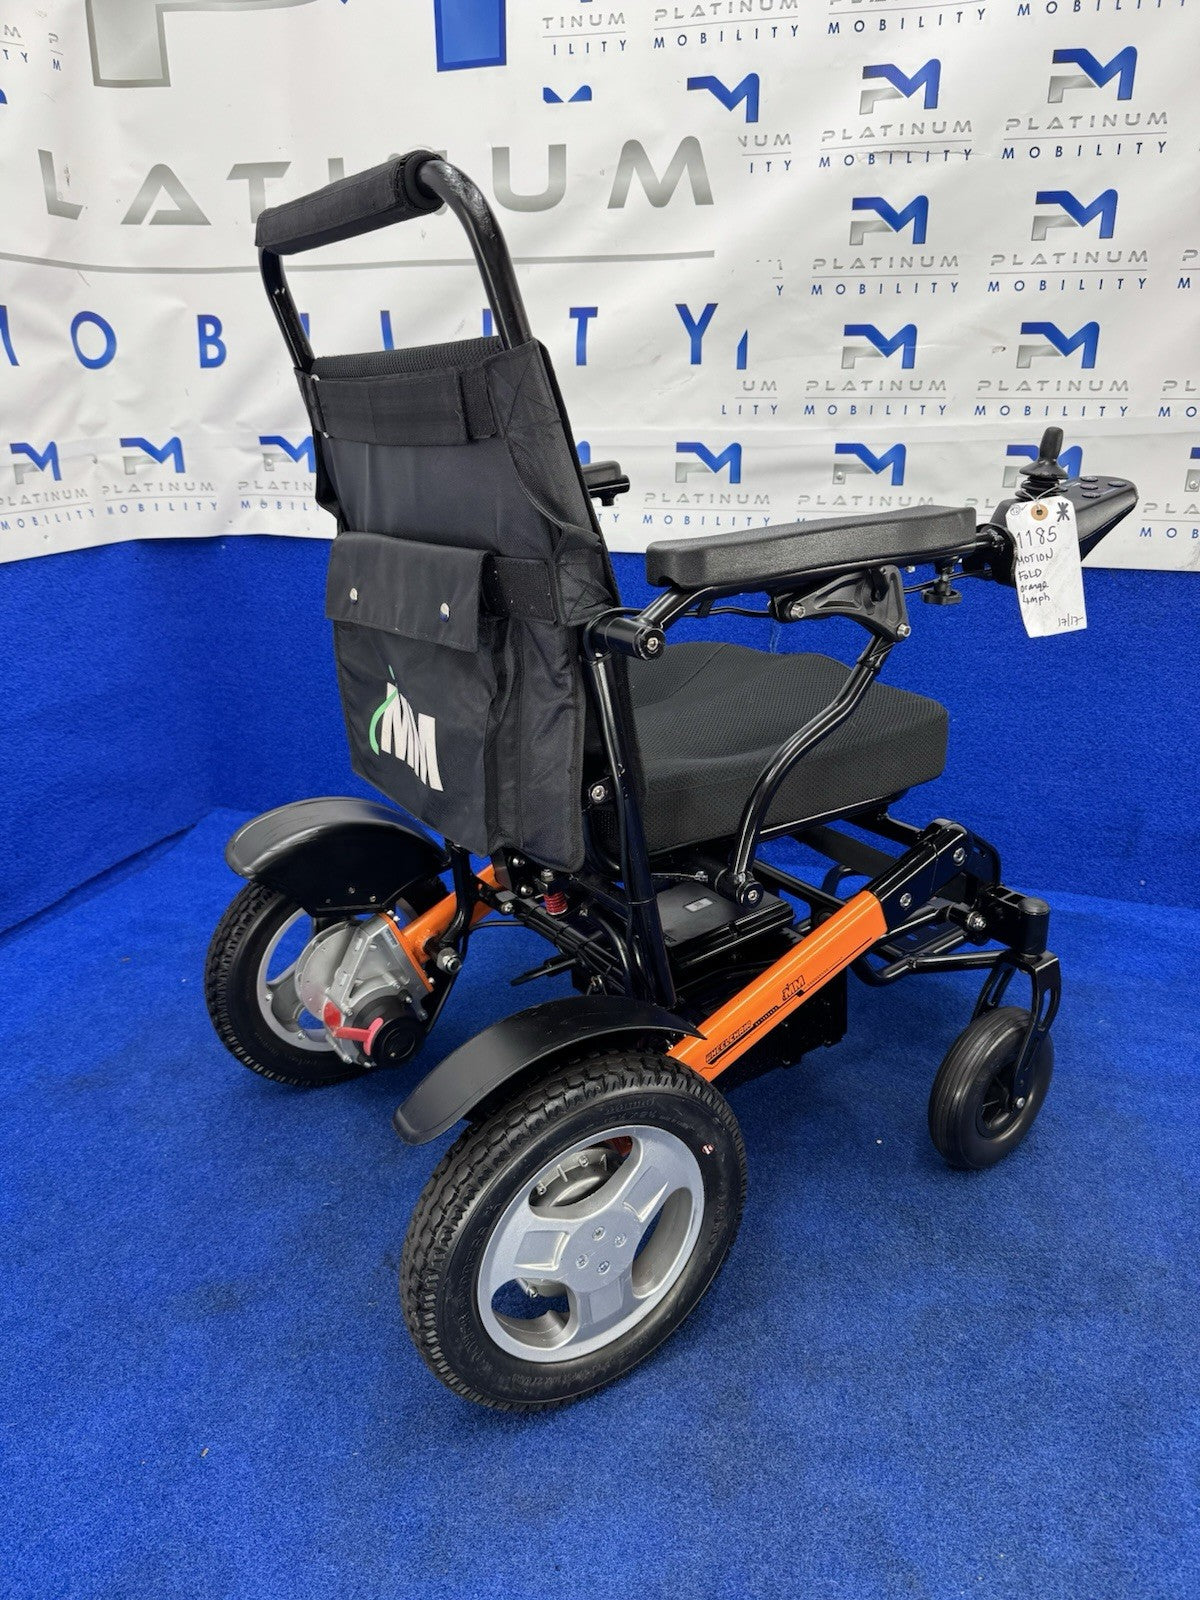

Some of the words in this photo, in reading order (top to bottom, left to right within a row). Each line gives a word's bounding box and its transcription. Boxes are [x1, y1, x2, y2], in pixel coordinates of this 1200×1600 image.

[827, 8, 986, 35] MOBILITY
[653, 24, 799, 49] MOBILITY
[1004, 111, 1168, 132] PLATINUM
[820, 120, 973, 143] PLATINUM
[818, 149, 973, 169] MOBILITY
[1001, 141, 1167, 160] MOBILITY
[812, 254, 960, 271] PLATINUM
[989, 249, 1149, 267] PLATINUM
[811, 280, 960, 297] MOBILITY
[987, 277, 1148, 293] MOBILITY
[805, 379, 948, 392] PLATINUM
[976, 379, 1130, 392] PLATINUM
[804, 405, 947, 416] MOBILITY
[974, 405, 1129, 417] MOBILITY
[102, 480, 215, 495] PLATINUM
[644, 492, 771, 505] PLATINUM
[797, 494, 934, 507] PLATINUM
[106, 502, 218, 515] MOBILITY
[0, 507, 95, 531] MOBILITY
[643, 514, 770, 526] MOBILITY
[1016, 525, 1057, 549] 1185
[1016, 547, 1054, 566] MOTION
